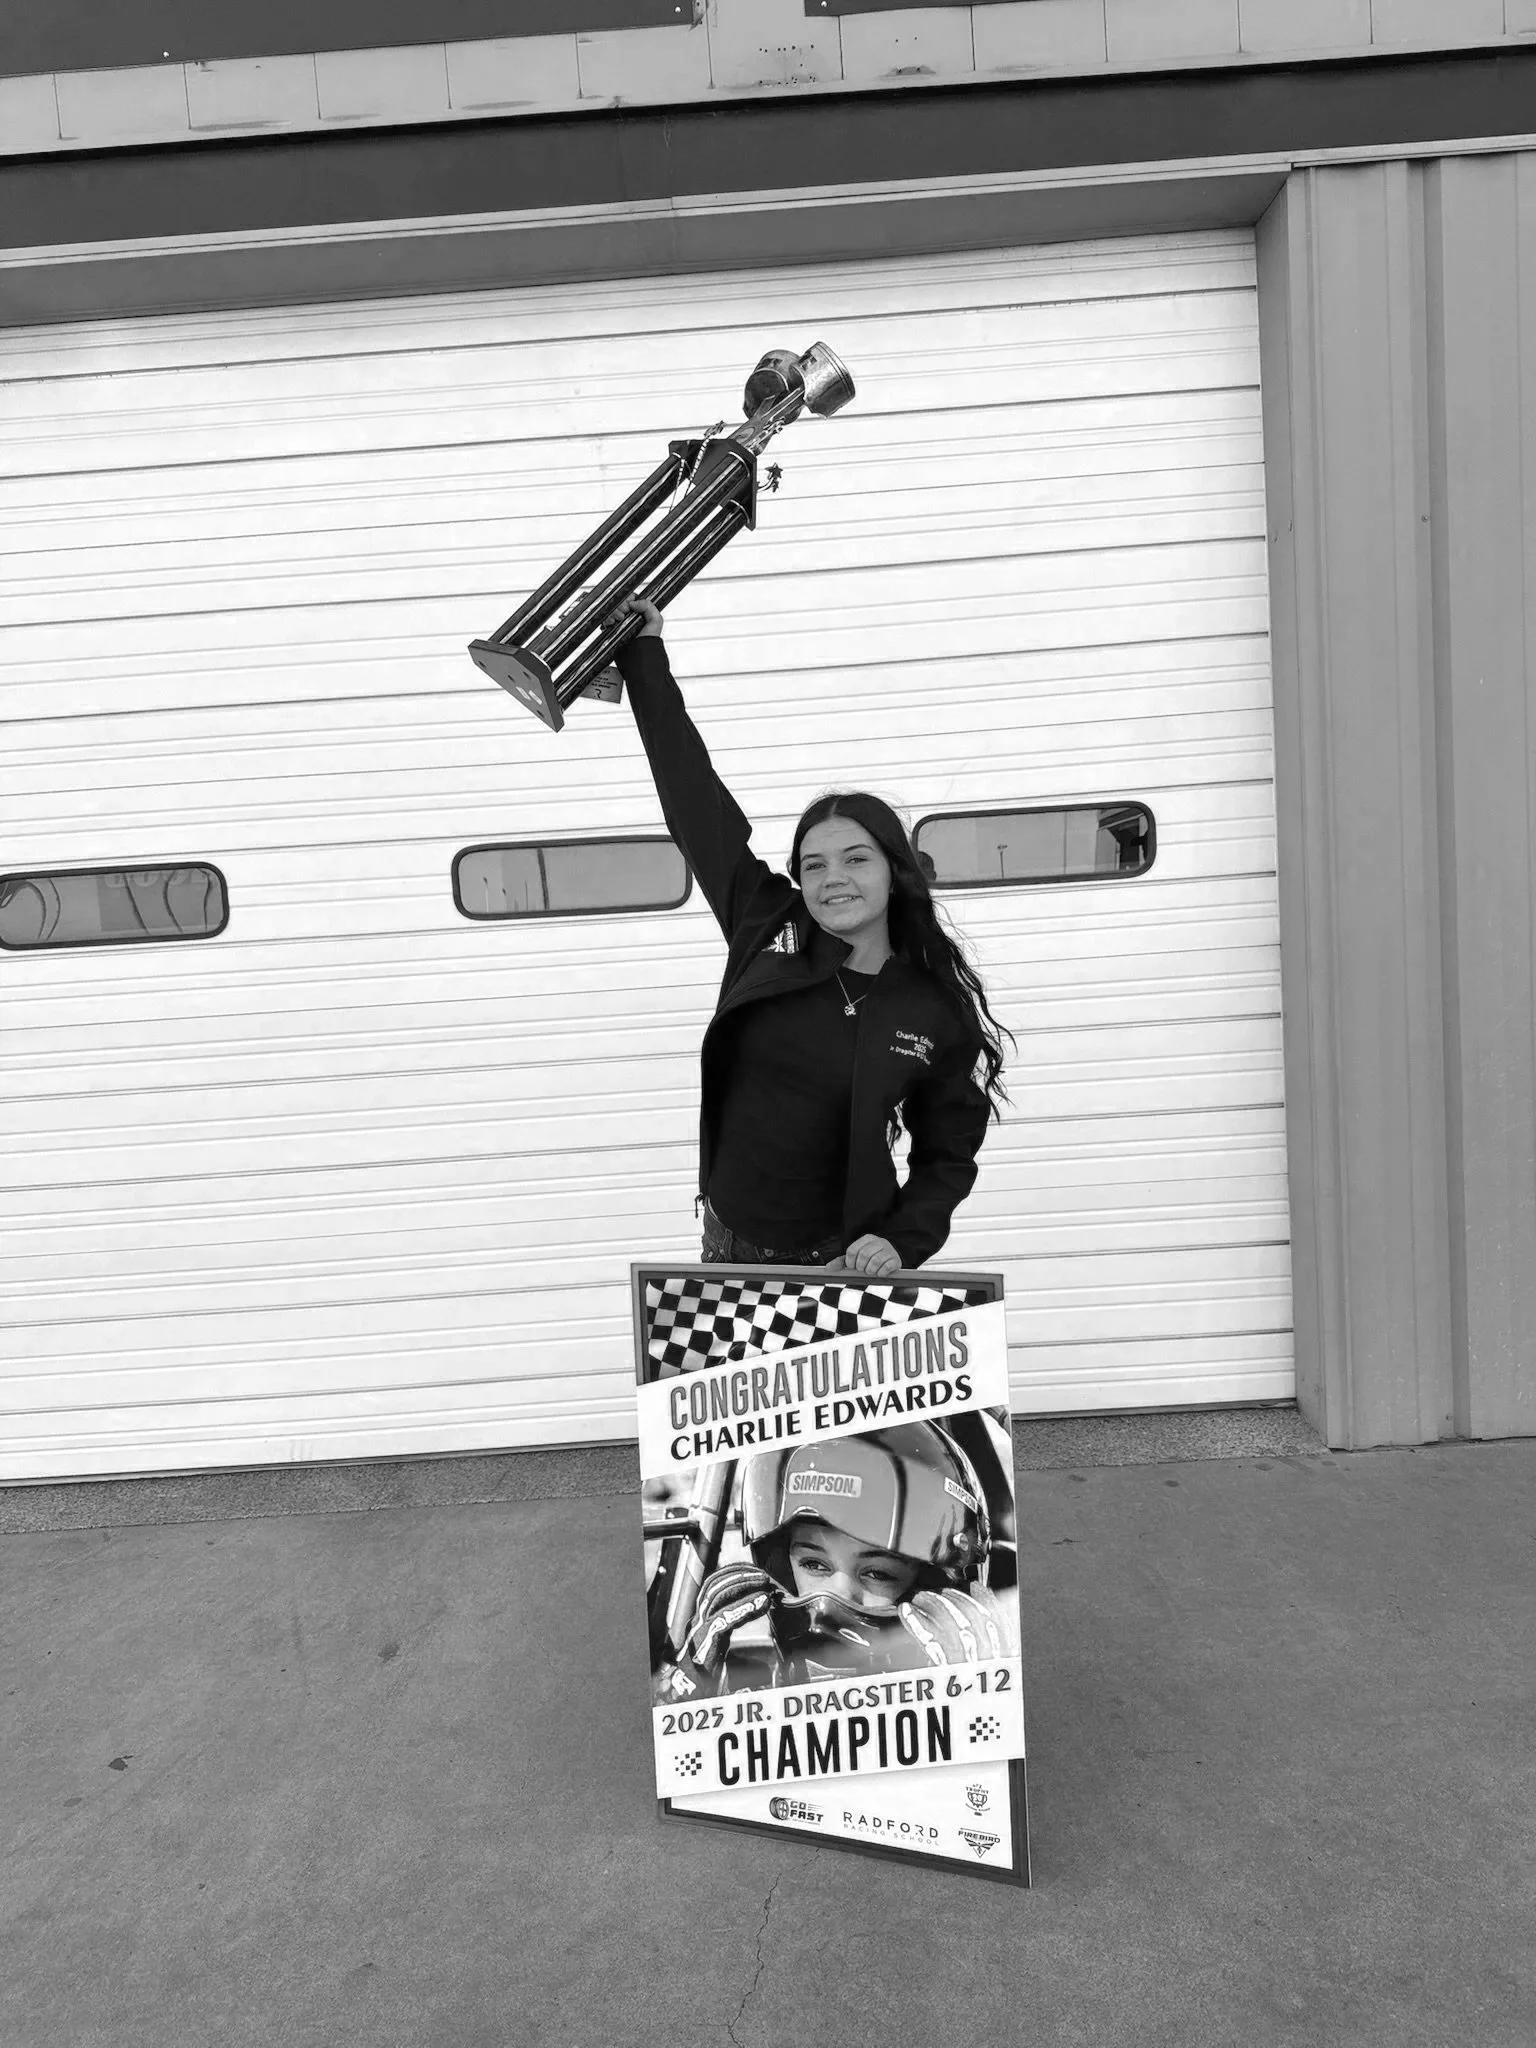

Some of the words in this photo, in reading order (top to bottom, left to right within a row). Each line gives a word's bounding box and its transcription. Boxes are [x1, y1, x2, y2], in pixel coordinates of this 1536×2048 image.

[670, 1321, 968, 1431] CONGRATULATIONS
[670, 1409, 802, 1461] CHARLIE
[814, 1374, 973, 1430] EDWARDS
[662, 1706, 725, 1736] 2025
[734, 1701, 772, 1725] JR.
[783, 1678, 934, 1718] DRAGSTER
[945, 1668, 1011, 1698] 6-12
[717, 1705, 952, 1787] CHAMPION
[790, 1801, 806, 1810] GO
[790, 1809, 824, 1822] FAST
[843, 1811, 938, 1838] RADFORD
[843, 1823, 886, 1836] RACING
[893, 1832, 939, 1846] SCHOOL
[958, 1830, 1001, 1844] FIREBIRD
